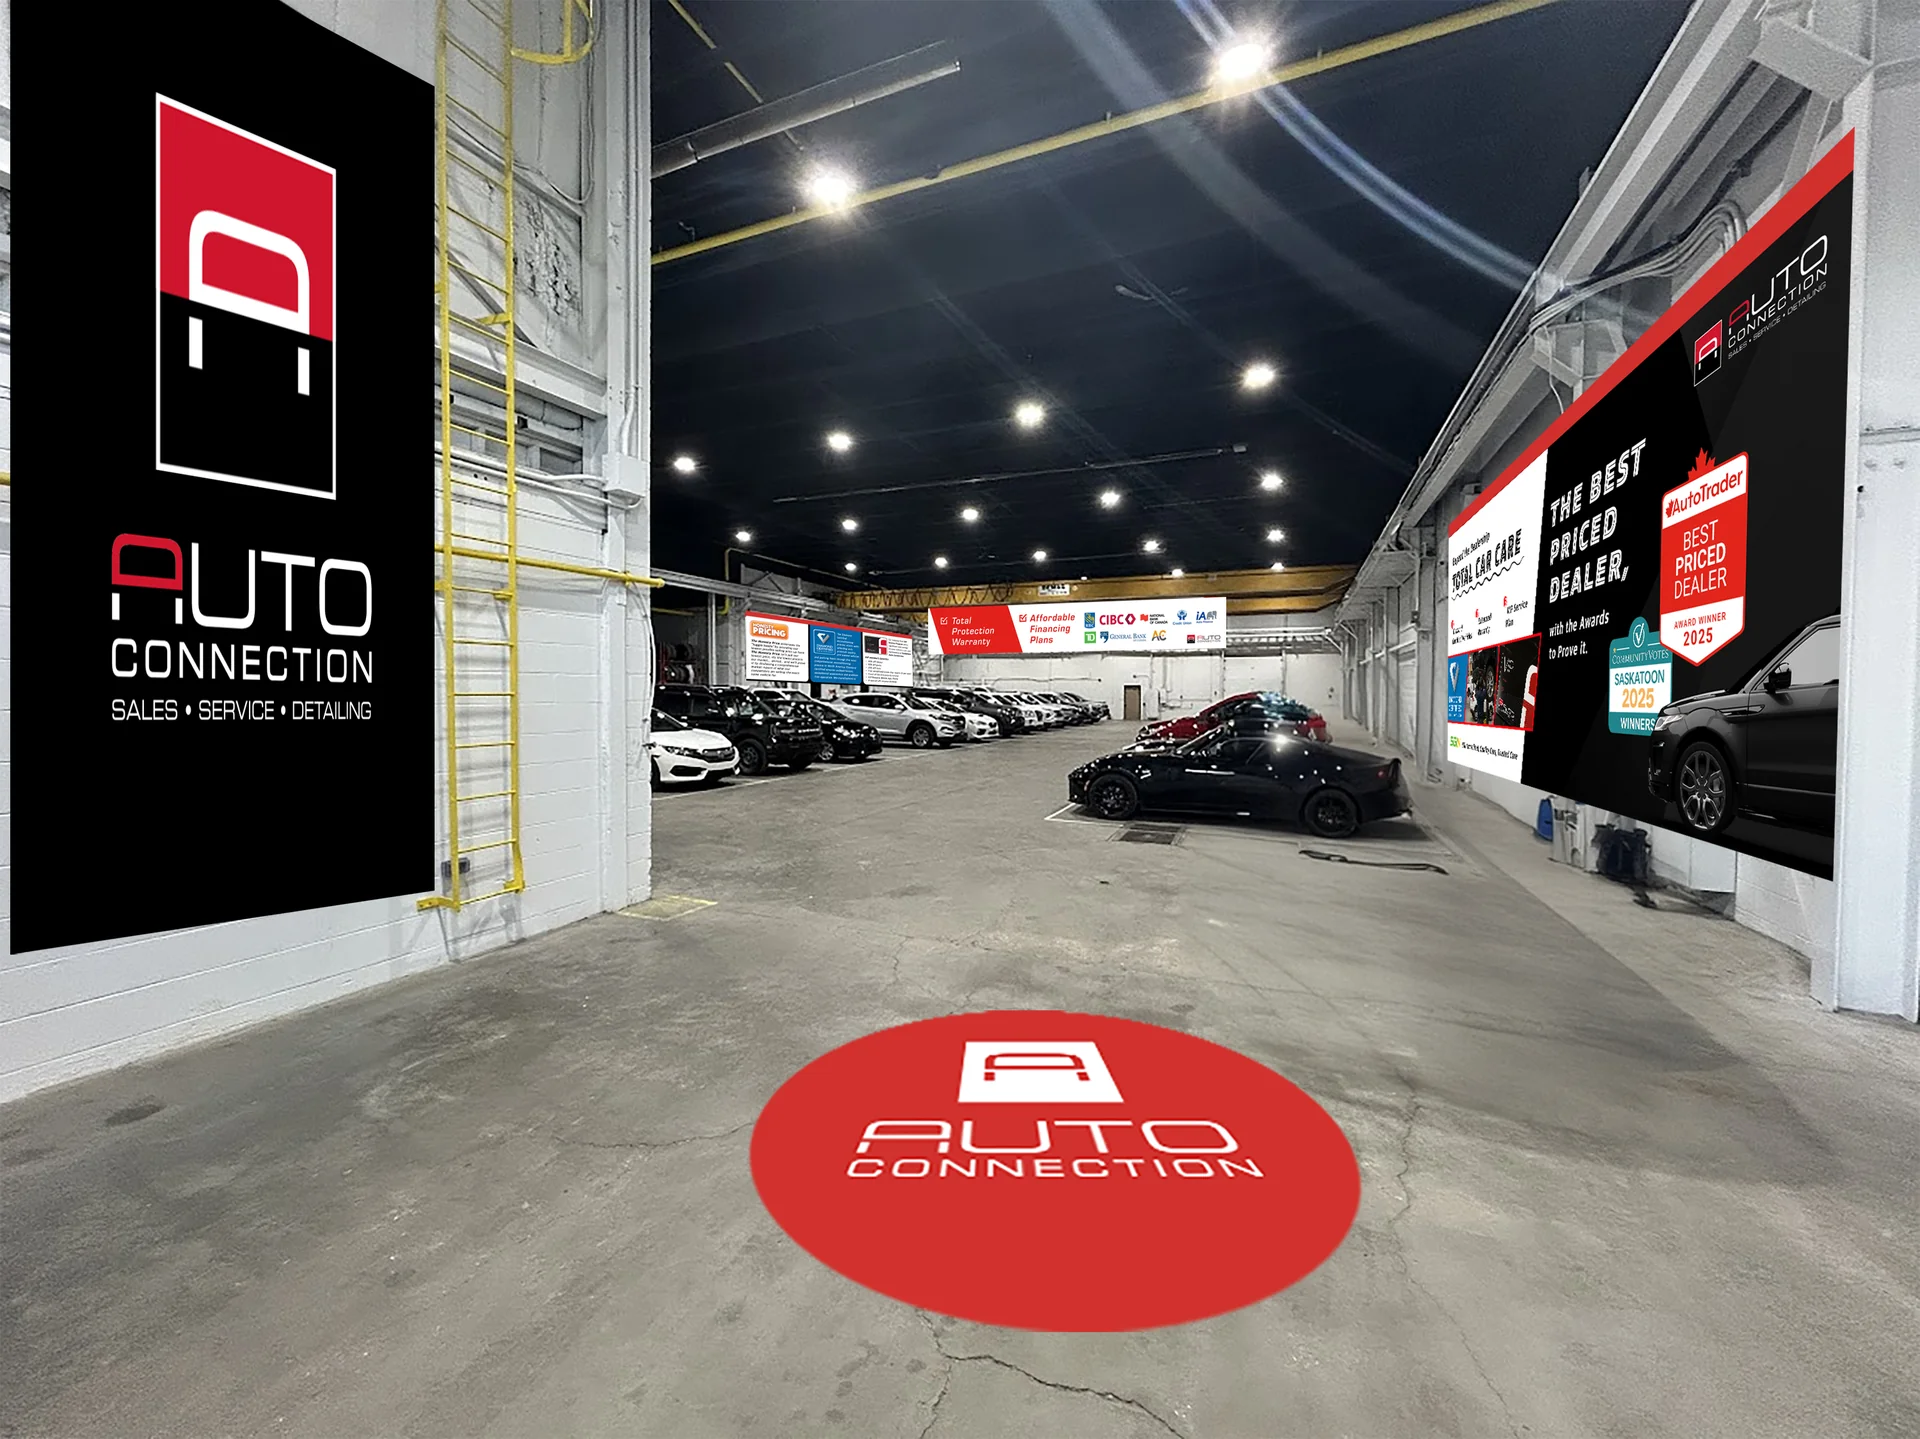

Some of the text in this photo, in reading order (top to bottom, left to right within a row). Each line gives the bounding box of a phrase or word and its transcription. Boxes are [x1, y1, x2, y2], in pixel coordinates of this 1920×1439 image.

[1728, 235, 1828, 335] AUTO
[1728, 263, 1828, 348] CONNECTION
[1550, 438, 1647, 528] THE BEST
[1672, 470, 1743, 516] AutoTrader
[1549, 506, 1618, 566] PRICED
[1683, 519, 1719, 551] BEST
[1475, 550, 1492, 579] CAR
[1494, 528, 1522, 568] CARE
[1675, 542, 1726, 577] PRICED
[111, 533, 373, 637] AUTO
[1549, 549, 1629, 604] DEALER,
[1674, 566, 1727, 600] DEALER
[952, 616, 972, 625] Total
[1029, 613, 1075, 622] Affordable
[1099, 614, 1124, 625] CIBC
[1549, 608, 1610, 637] with the Awards
[1673, 611, 1727, 630] AWARD WINNER
[752, 626, 787, 638] PRICING
[951, 627, 995, 636] Protection
[1029, 625, 1071, 634] Financing
[1029, 636, 1053, 644] Plans
[1085, 633, 1096, 642] TD
[1683, 627, 1713, 647] 2025
[952, 638, 991, 646] Warranty
[1548, 641, 1588, 660] to Prove it.
[111, 637, 373, 683] CONNECTION
[1614, 669, 1665, 686] SASKATOON
[1621, 687, 1655, 709] 2025
[111, 698, 372, 721] SALES SERVICE DETAILING
[1620, 717, 1656, 731] WINNERS
[856, 1119, 1239, 1154] AUTO
[846, 1158, 1265, 1178] CONNECTION
